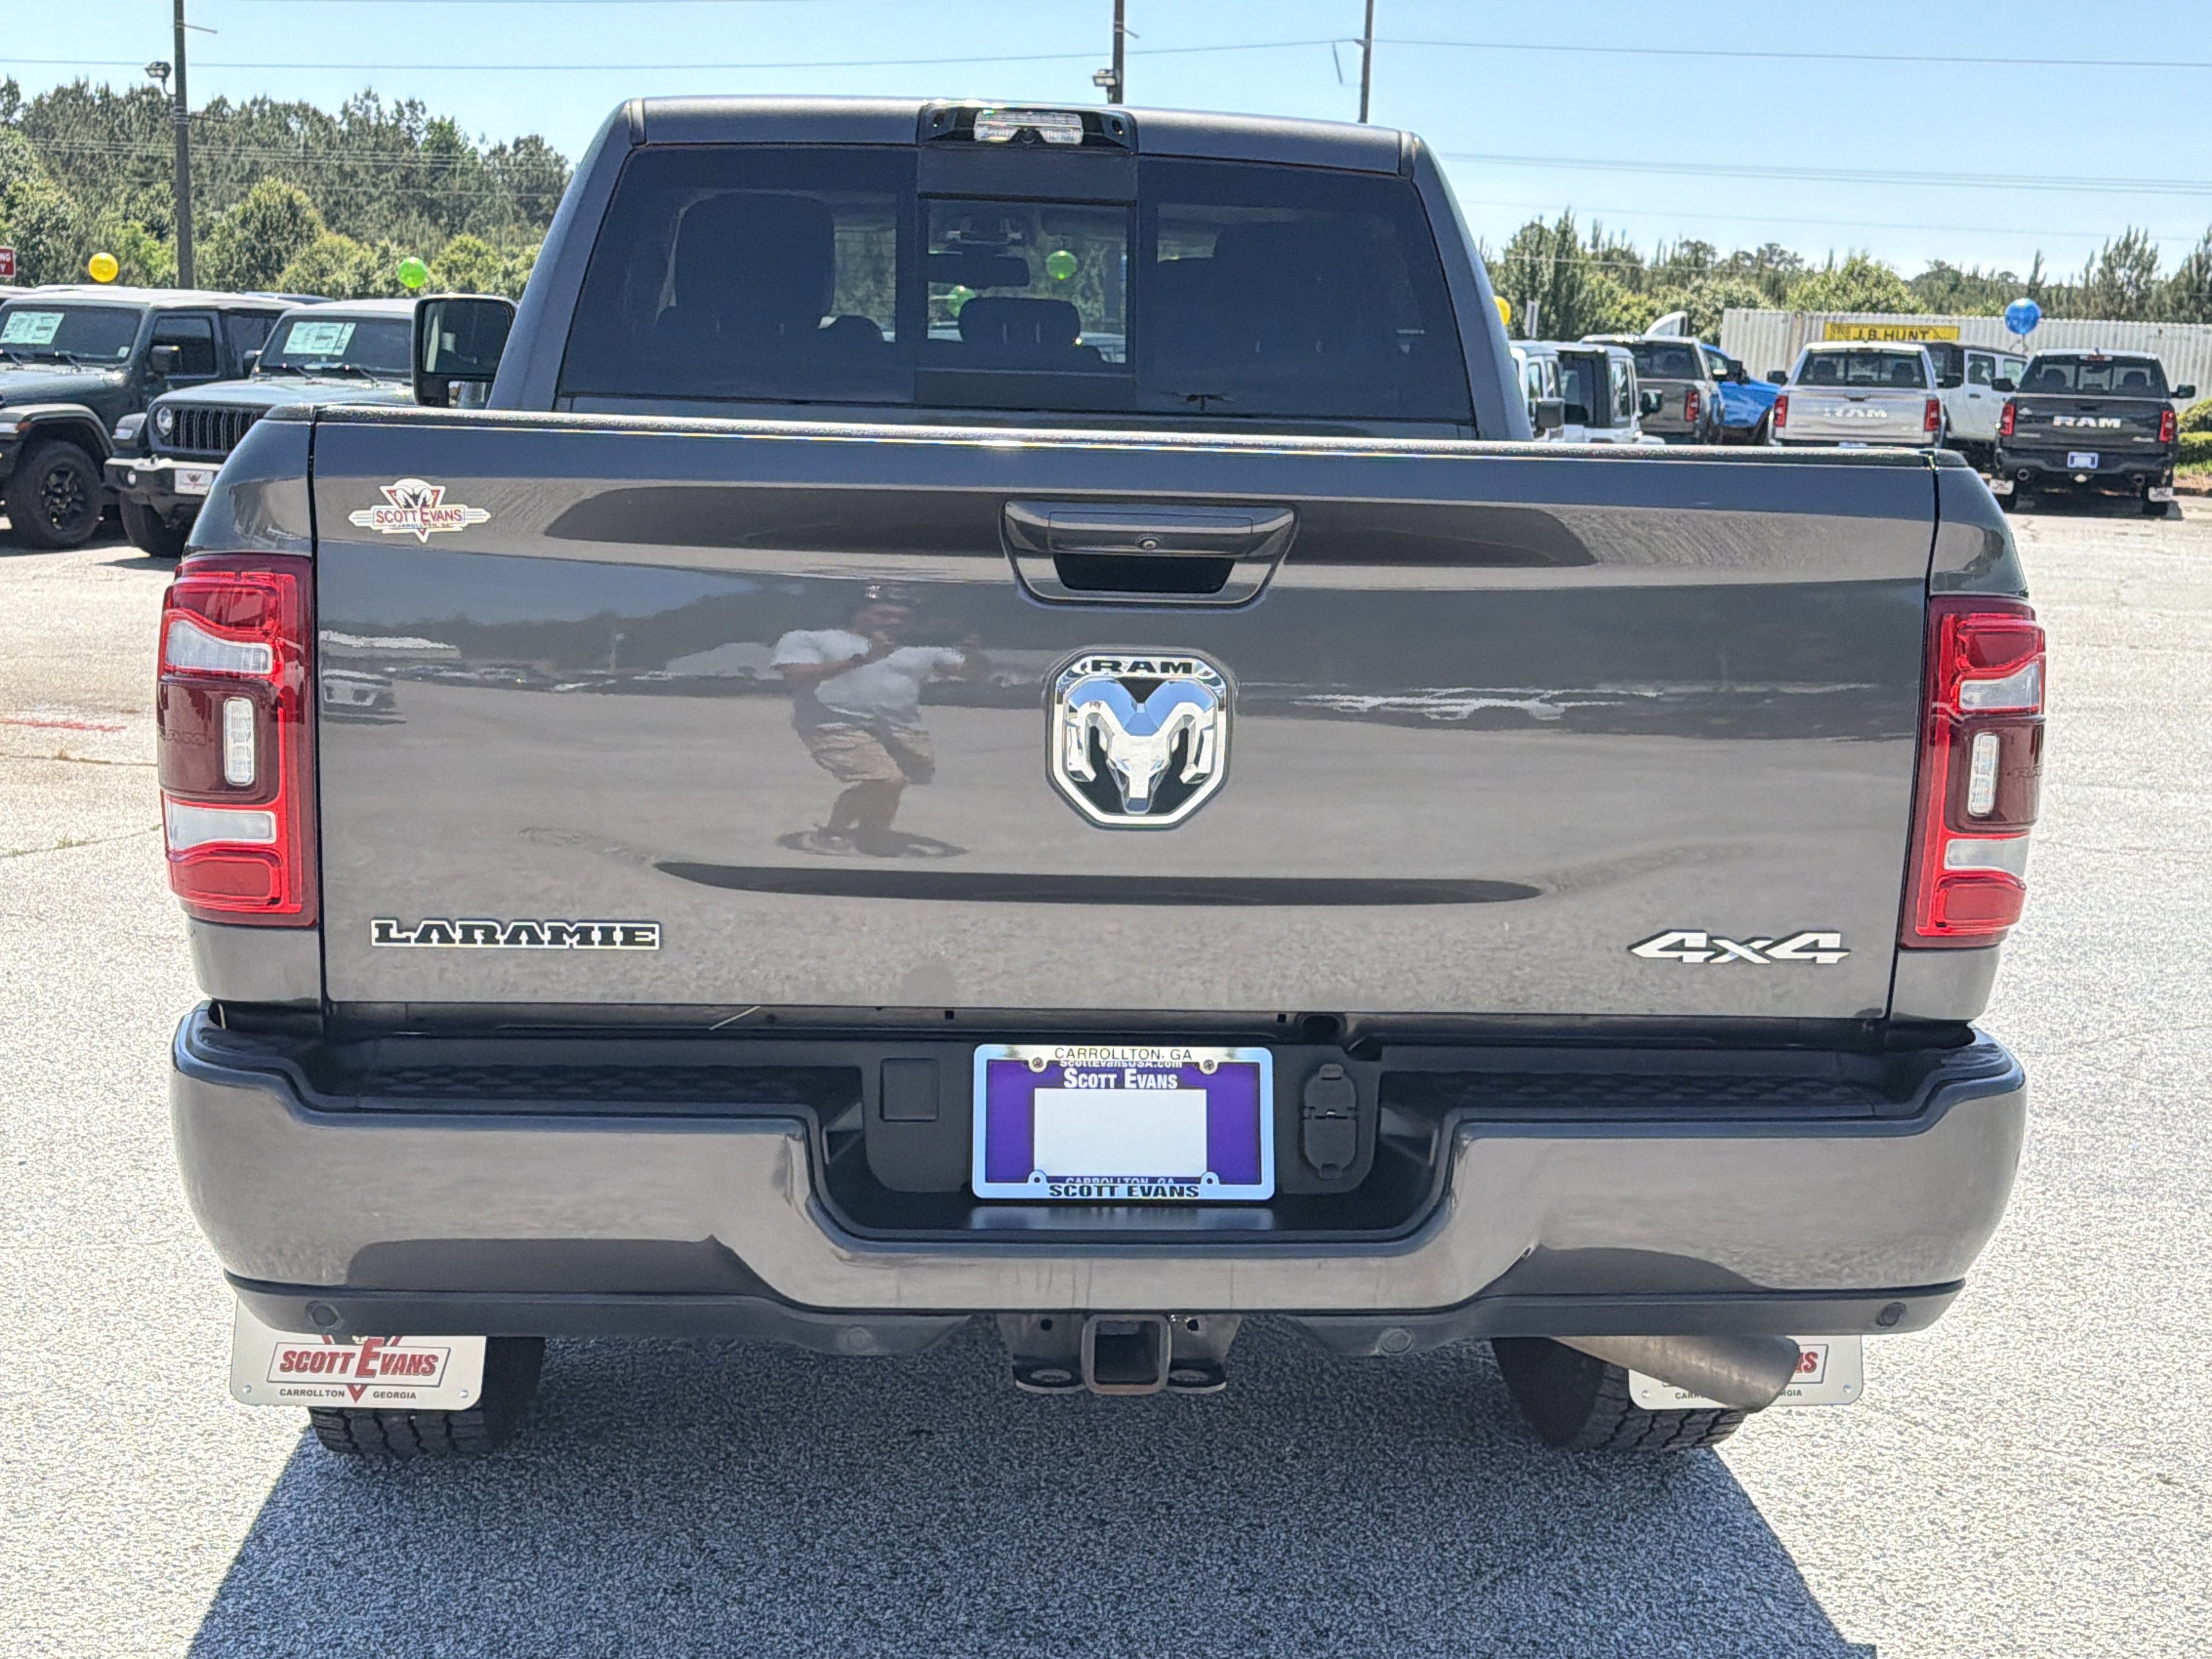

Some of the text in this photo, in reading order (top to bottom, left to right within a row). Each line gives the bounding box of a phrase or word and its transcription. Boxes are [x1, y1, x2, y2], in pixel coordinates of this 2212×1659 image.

[1883, 329, 1929, 341] HUNT
[2053, 415, 2121, 428] RAM
[376, 507, 462, 523] SCOTT EVANS
[1091, 659, 1193, 674] RAM
[371, 919, 659, 950] LARAMIE
[1170, 1048, 1192, 1060] GA
[1049, 1184, 1199, 1198] SCOTT EVANS
[279, 1336, 439, 1378] SCOTT EVANS
[279, 1388, 416, 1399] CARROLLTON GEORGIA
